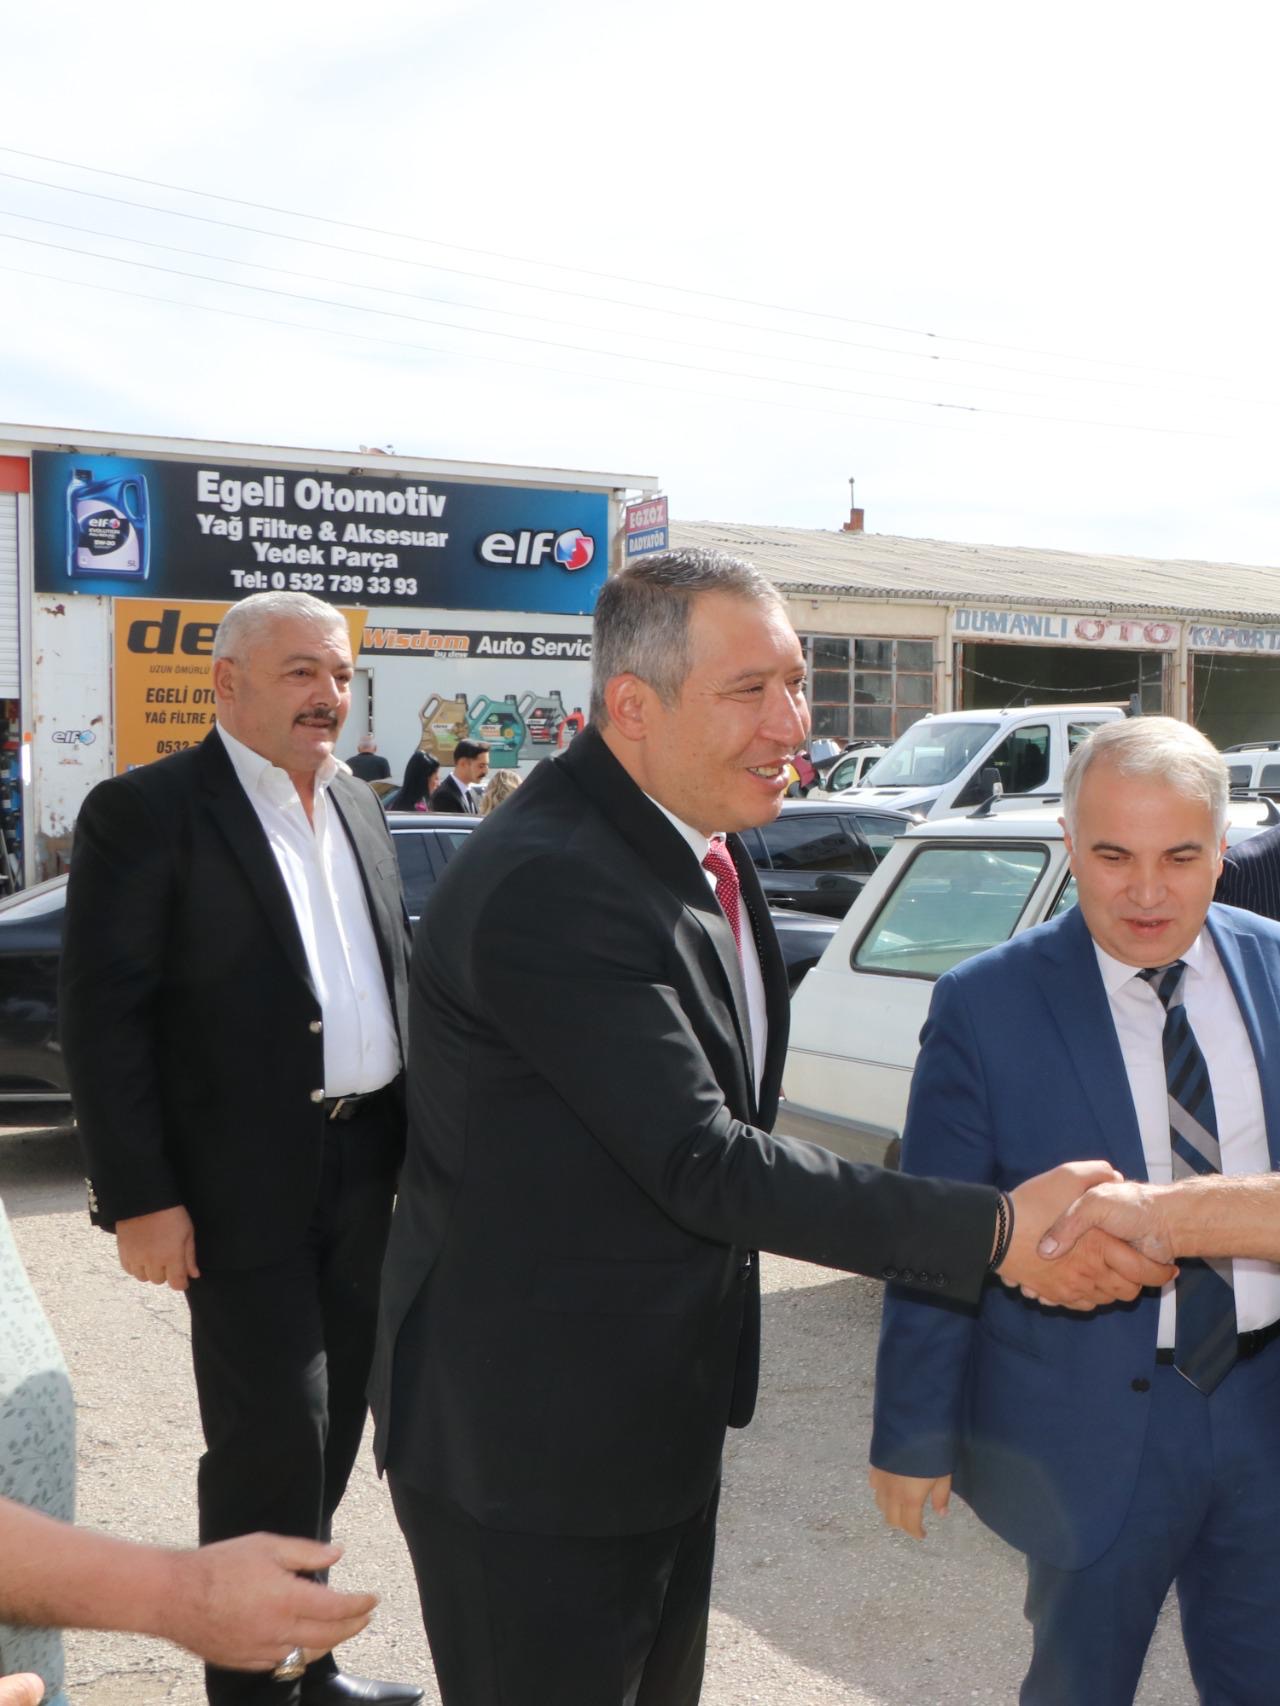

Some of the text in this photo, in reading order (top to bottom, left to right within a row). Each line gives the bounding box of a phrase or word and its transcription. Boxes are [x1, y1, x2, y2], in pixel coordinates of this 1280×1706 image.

[197, 470, 447, 517] Egeli Otomotiv
[88, 518, 110, 528] elf
[628, 505, 665, 529] EGZOZ
[197, 514, 449, 547] Yağ Filtre & Aksesuar
[628, 531, 665, 553] RADYATÖR
[252, 541, 398, 573] Yedek Parça
[481, 531, 554, 566] elf
[231, 570, 418, 595] Tel: 0 532 739 33 93
[955, 608, 1068, 639] DUMANLI
[1074, 618, 1173, 644] OTO
[362, 628, 470, 651] Wisdom
[476, 635, 526, 655] Auto
[433, 651, 447, 659] by
[149, 664, 210, 675] UZUN ÖMÜRLÜ
[146, 685, 188, 704] EGELİ
[144, 711, 166, 724] YAĞ
[170, 710, 206, 724] FİLTRE
[51, 730, 81, 744] elf
